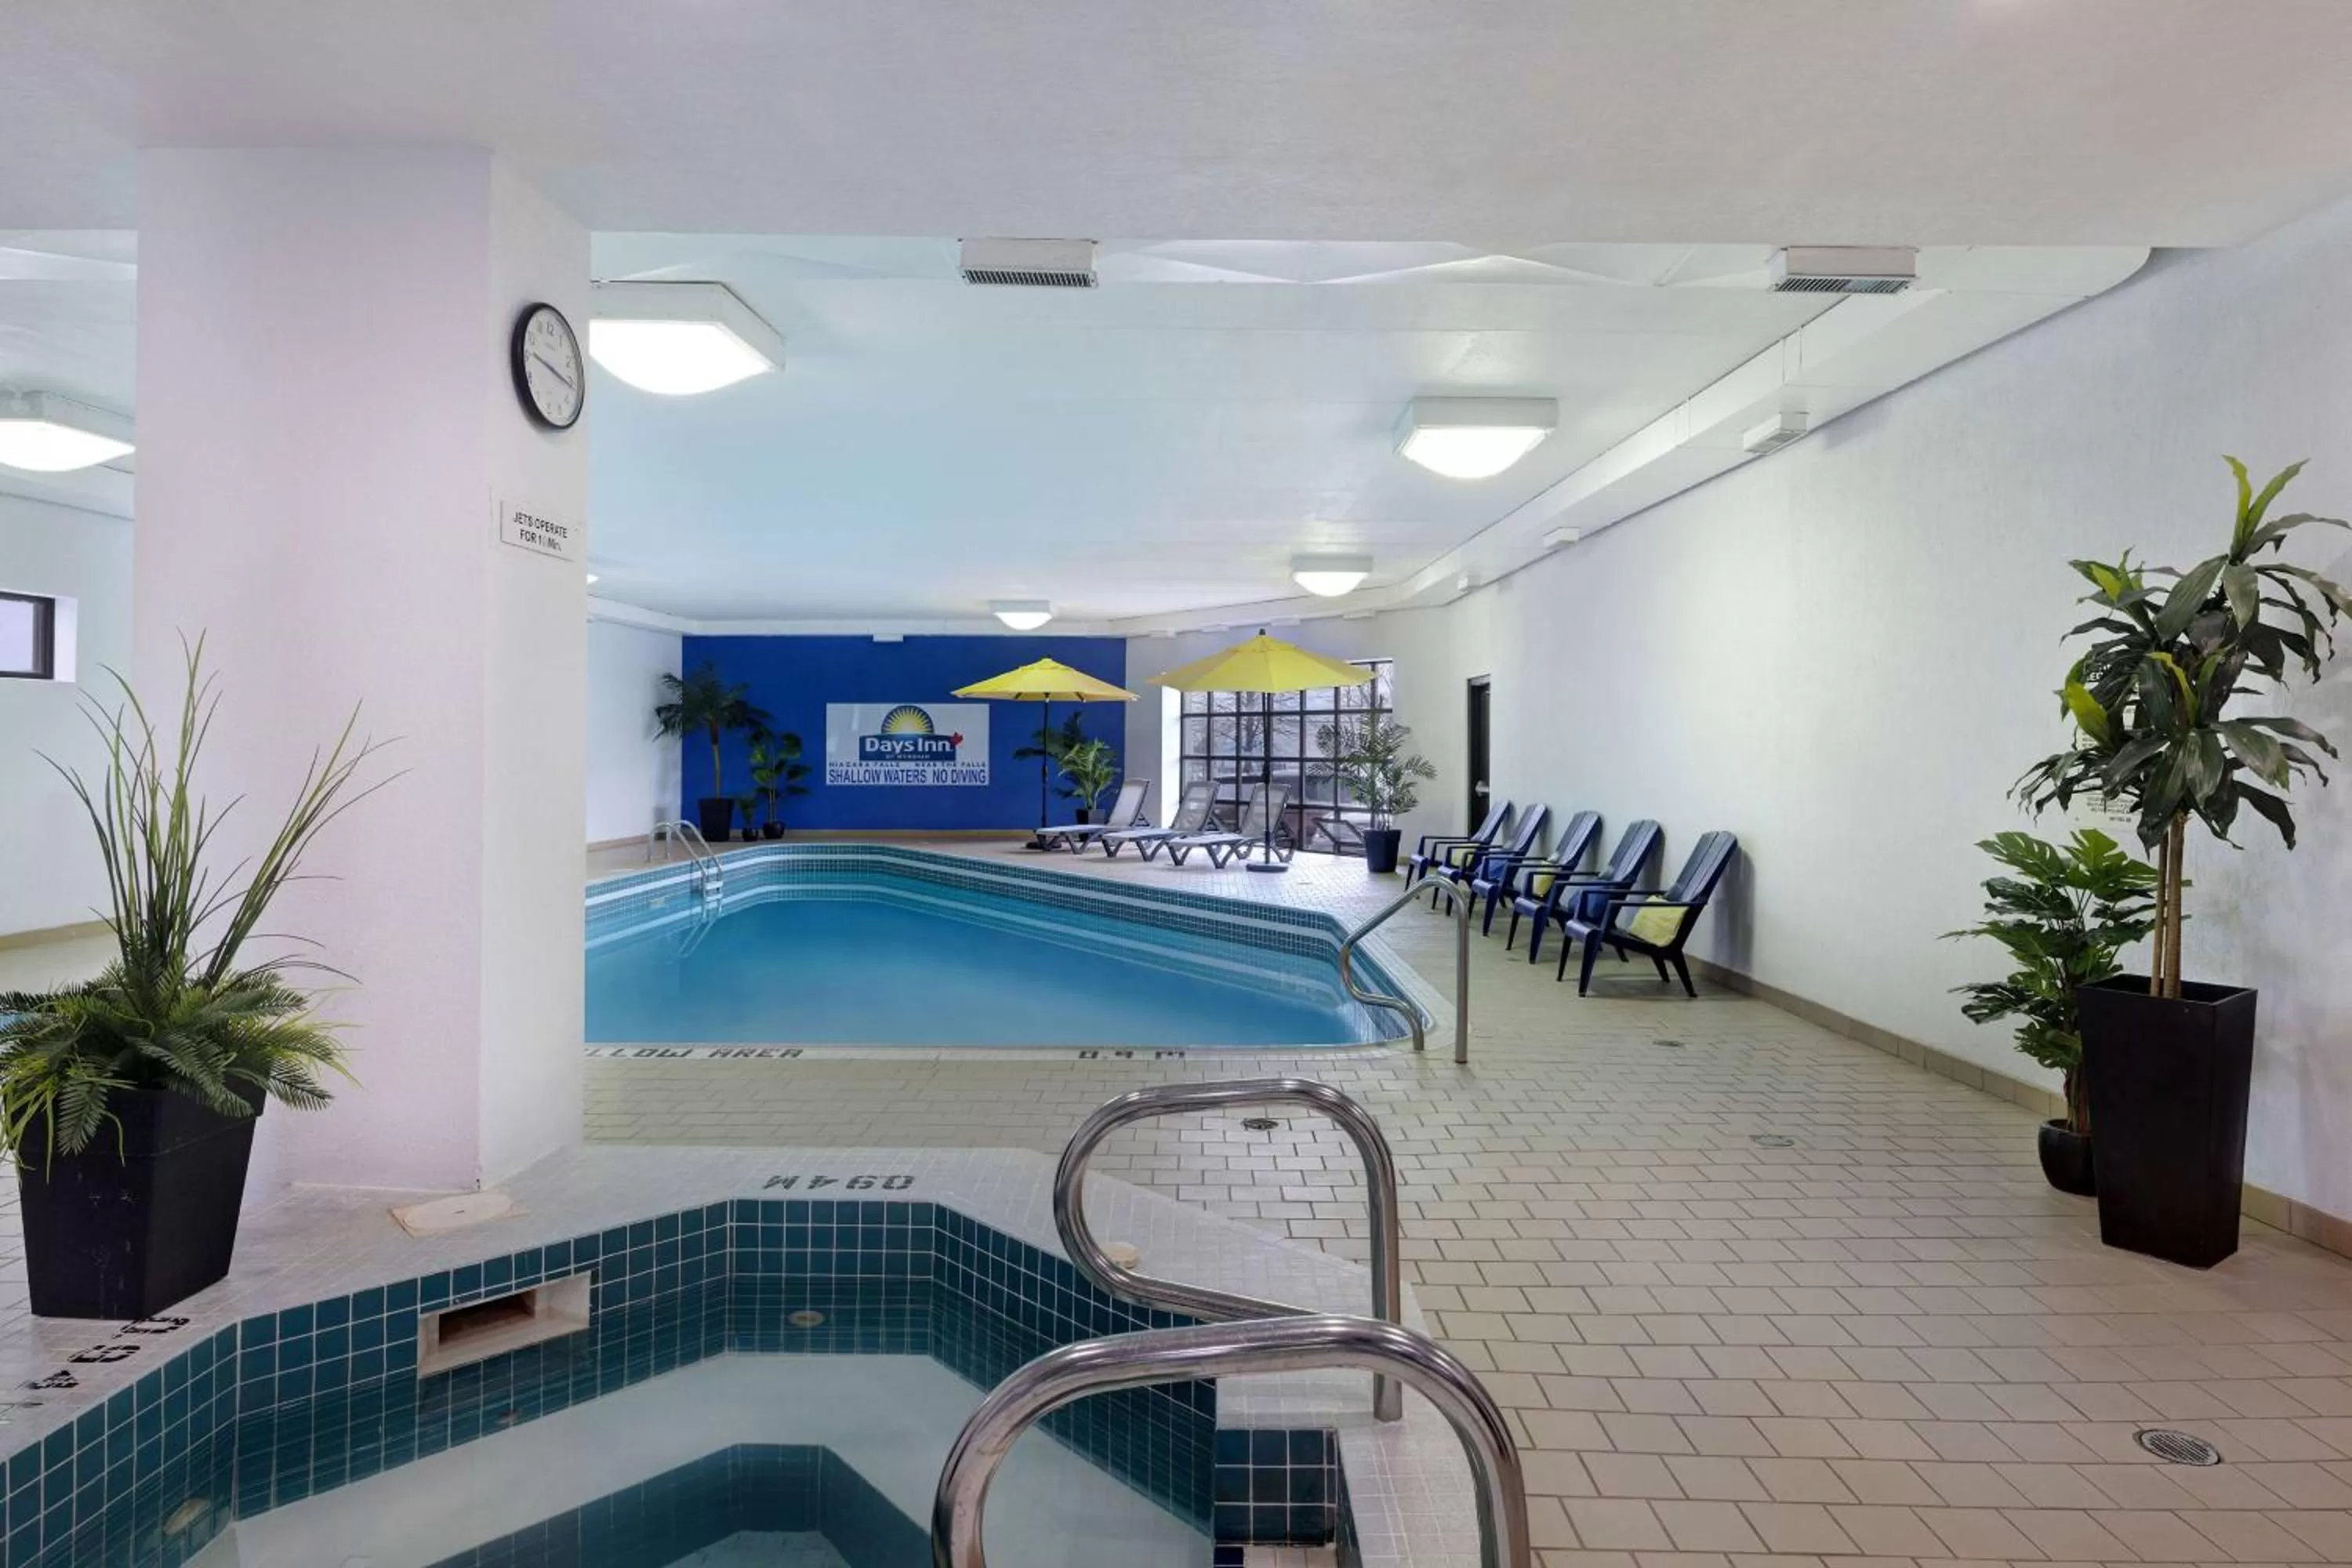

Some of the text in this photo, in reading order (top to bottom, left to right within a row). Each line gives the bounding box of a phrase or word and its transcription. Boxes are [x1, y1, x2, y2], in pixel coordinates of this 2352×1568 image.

[514, 511, 568, 539] JETS OPERATE
[520, 528, 537, 544] FOR
[865, 738, 950, 754] Days Inn
[829, 768, 986, 783] SHALLOW WATERS NO DIVING
[708, 1047, 804, 1058] AREA
